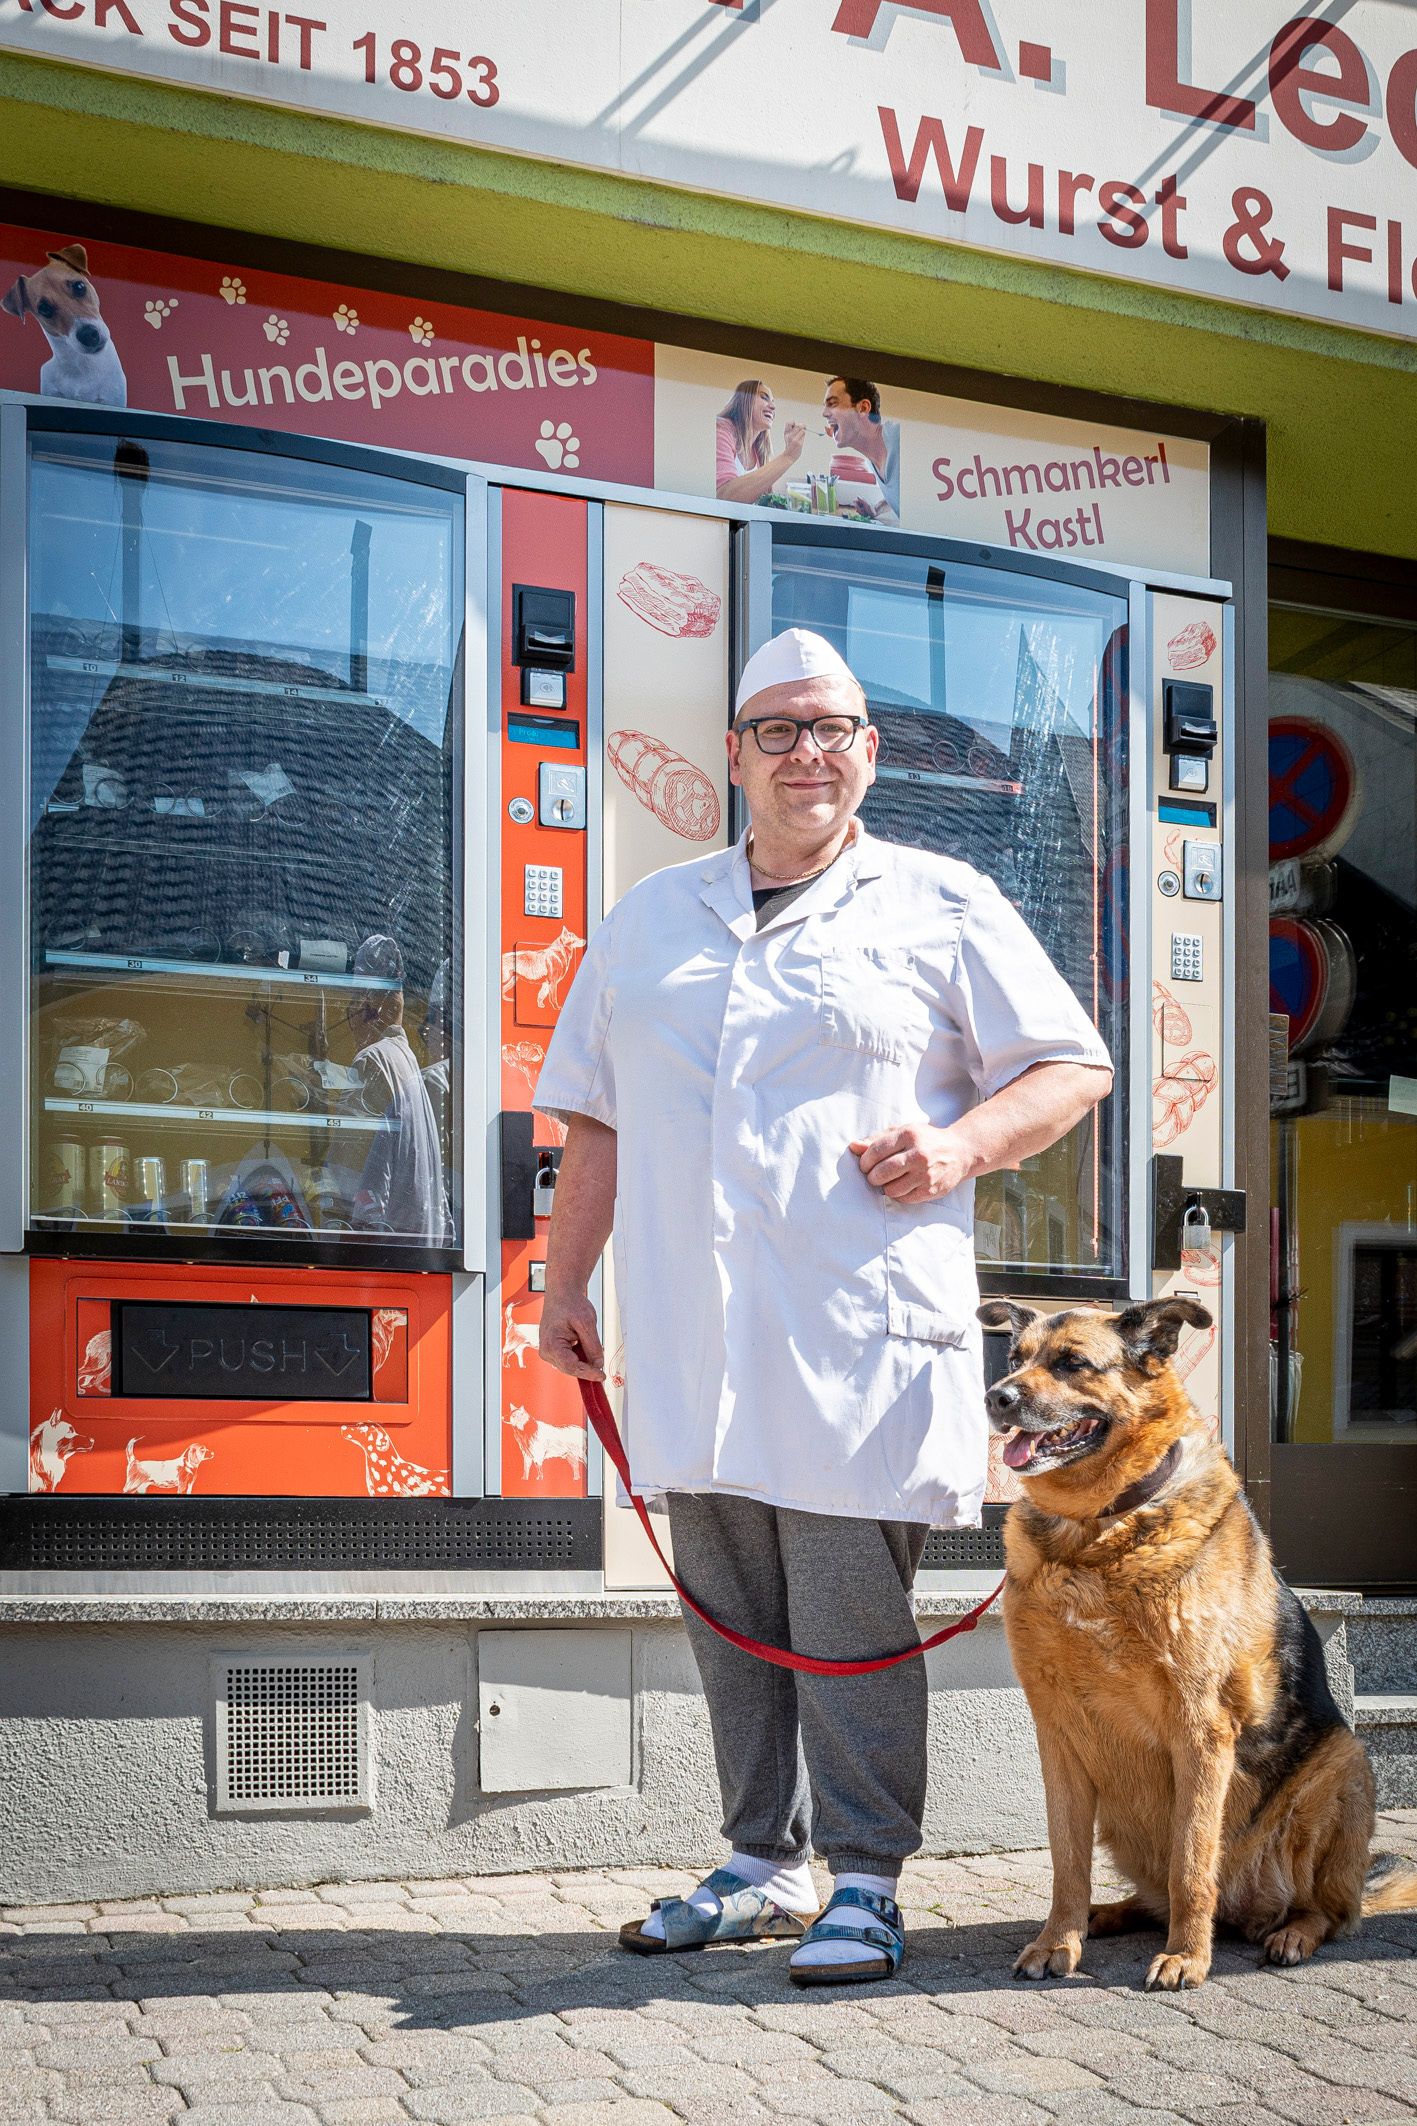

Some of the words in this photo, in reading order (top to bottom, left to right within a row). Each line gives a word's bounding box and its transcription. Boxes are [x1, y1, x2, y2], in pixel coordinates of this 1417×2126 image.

[167, 0, 326, 70] SEIT
[352, 32, 500, 108] 1853
[1145, 0, 1417, 171] Le
[877, 106, 1189, 260] Wurst
[1222, 186, 1291, 282] &
[1327, 205, 1417, 305] Fl
[166, 335, 598, 410] Hundeparadies
[931, 441, 1171, 502] Schmankerl
[1004, 502, 1105, 550] Kastl
[84, 663, 97, 672] 10
[173, 674, 186, 683] 12
[128, 960, 142, 968] 30
[79, 1103, 93, 1112] 40
[200, 1111, 213, 1119] 42
[327, 1119, 341, 1127] 45
[188, 1338, 307, 1373] PUSH
